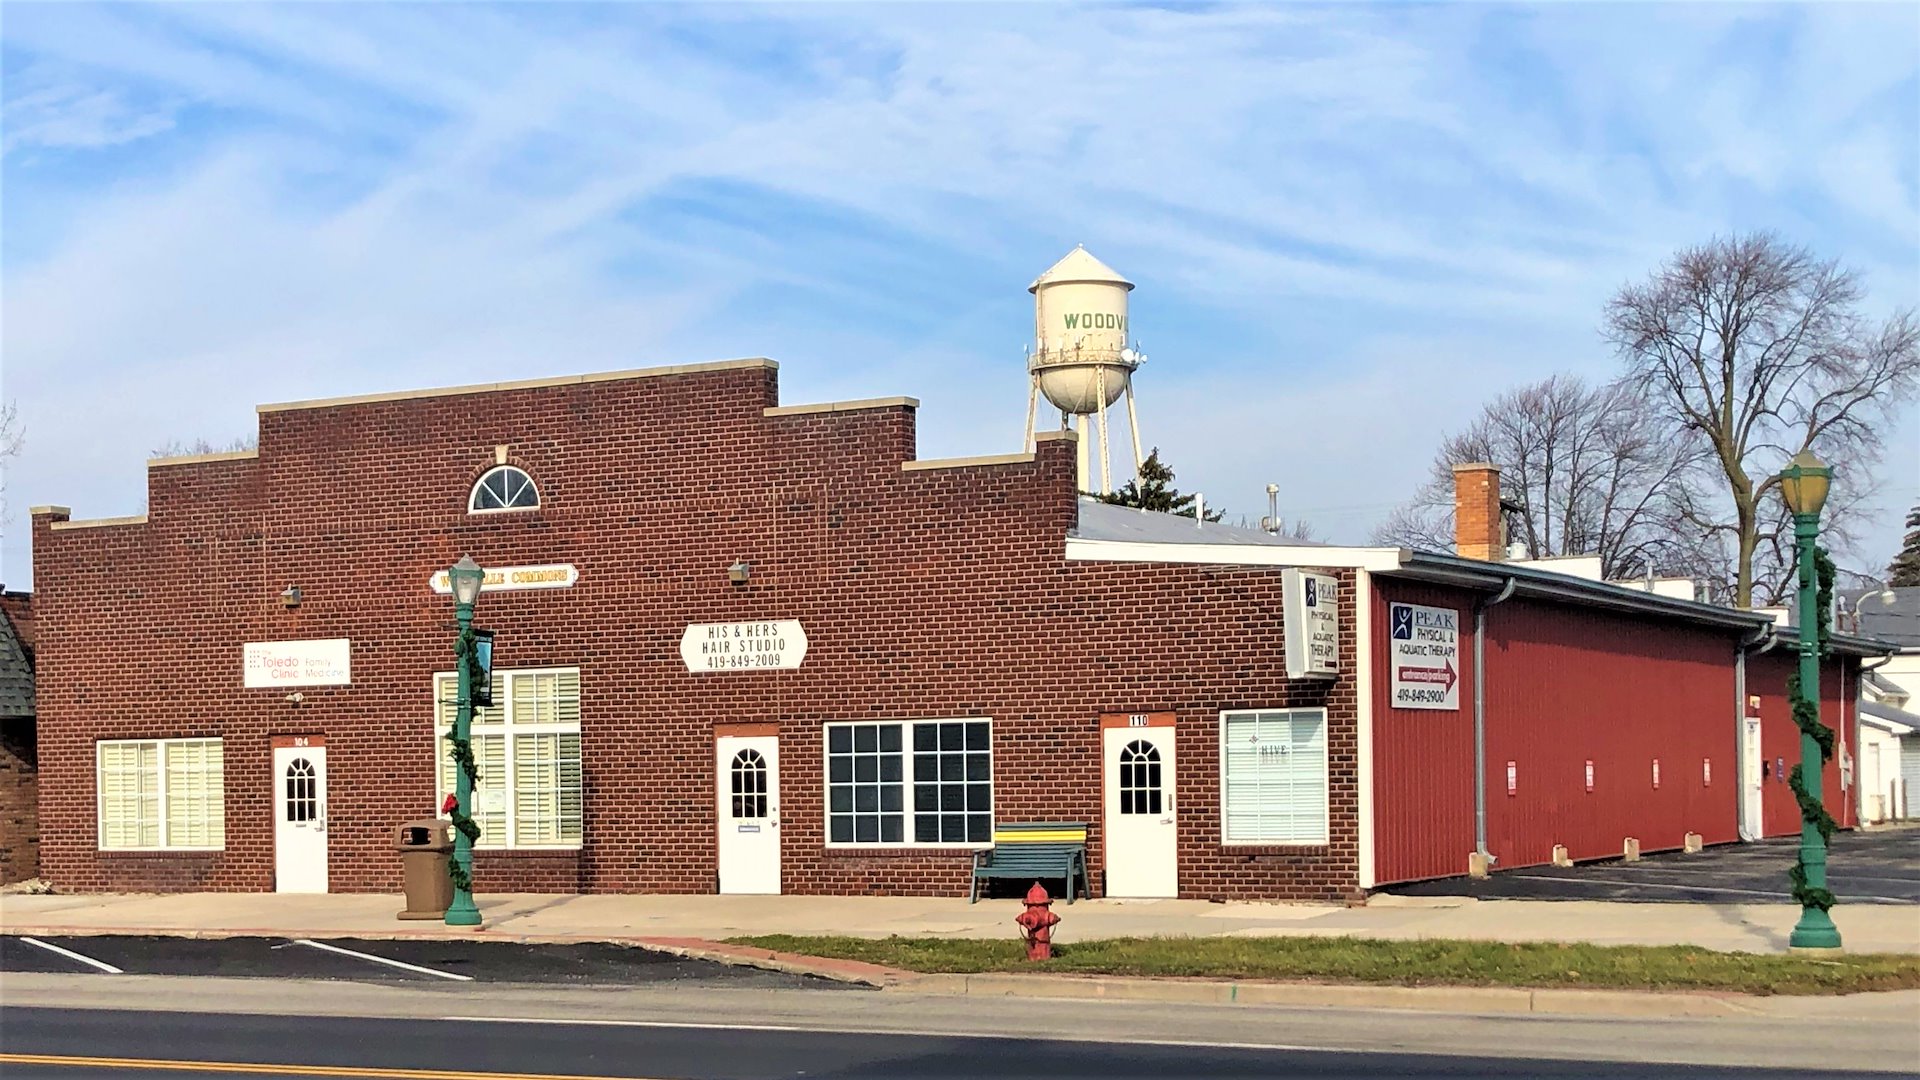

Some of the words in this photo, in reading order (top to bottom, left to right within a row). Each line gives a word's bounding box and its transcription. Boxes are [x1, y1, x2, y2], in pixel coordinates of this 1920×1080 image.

[512, 569, 567, 583] COMMONS
[1318, 583, 1337, 600] PEAK
[1311, 611, 1334, 621] PHYSICAL
[1416, 611, 1454, 628] PEAK
[708, 625, 728, 639] HIS
[734, 625, 741, 637] &
[747, 623, 778, 637] HERS
[1313, 632, 1334, 642] AQUATIC
[1417, 628, 1446, 643] PHYSICAL
[1449, 632, 1454, 643] &
[702, 641, 730, 654] HAIR
[740, 638, 785, 652] STUDIO
[1311, 644, 1334, 657] THERAPY
[1399, 644, 1427, 656] AQUATIC
[1428, 644, 1456, 657] THERAPY
[263, 656, 299, 668] Toledo
[305, 657, 331, 667] Family
[707, 653, 781, 668] 419-849-2009
[271, 668, 299, 679] Clinic
[1397, 689, 1445, 703] 419-849-2900
[1131, 715, 1148, 726] 110
[294, 737, 309, 746] 104
